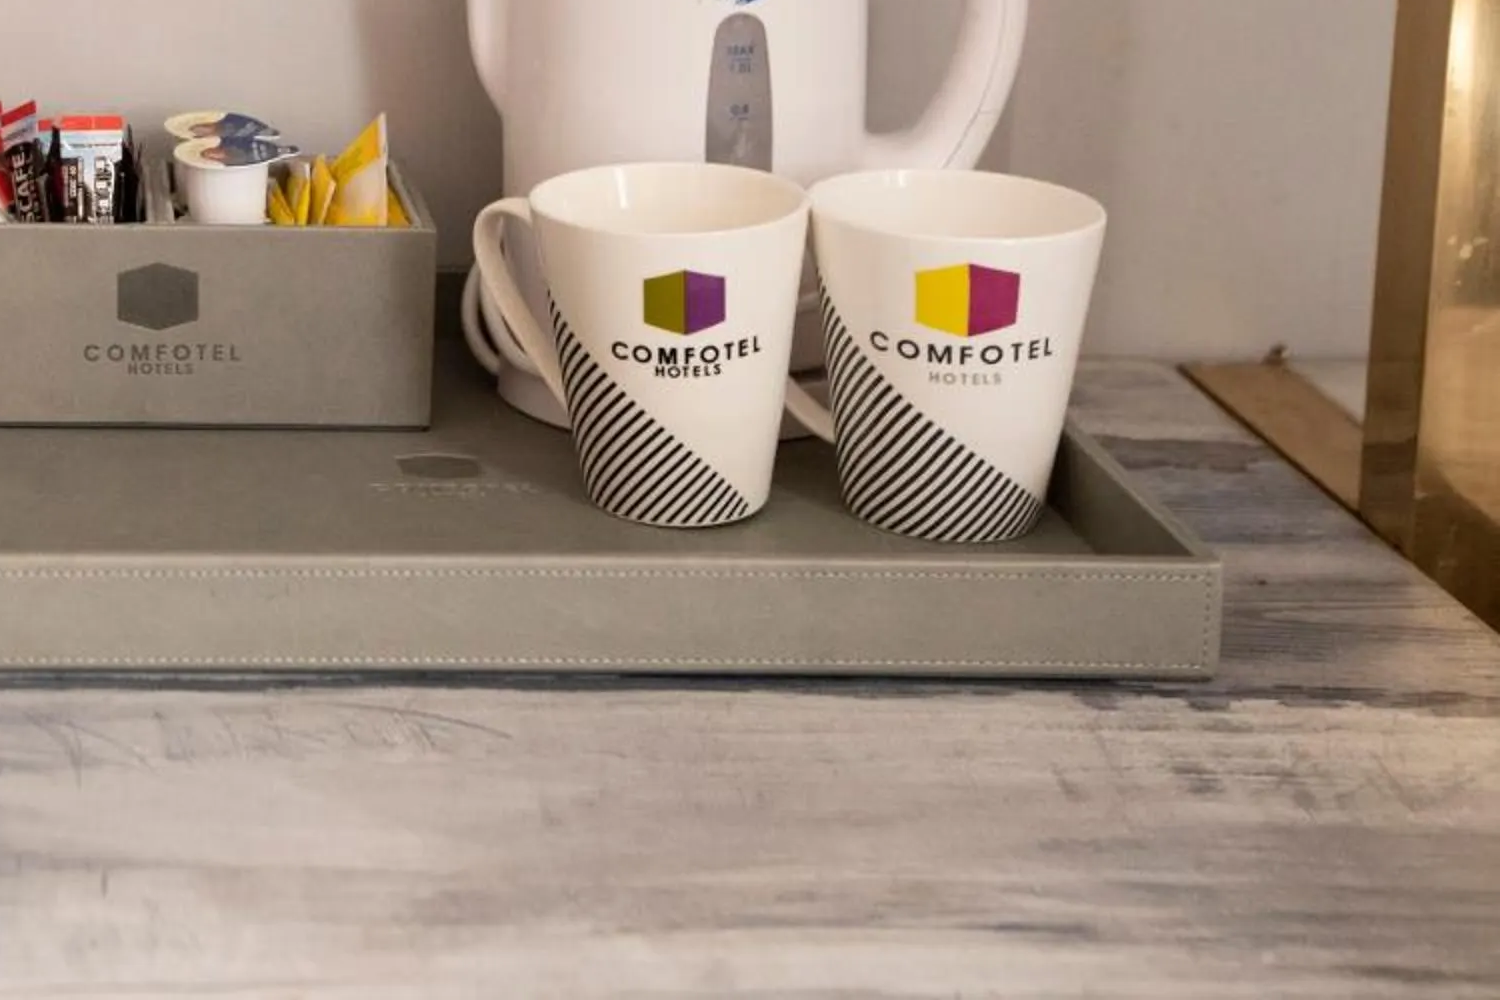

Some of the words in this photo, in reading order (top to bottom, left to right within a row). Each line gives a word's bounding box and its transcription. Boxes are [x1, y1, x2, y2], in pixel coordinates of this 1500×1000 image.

[83, 343, 242, 362] COMFOTEL
[611, 336, 761, 365] COMFOTEL
[868, 331, 1053, 365] COMFOTEL
[127, 362, 195, 375] HOTELS
[655, 364, 722, 379] HOTELS
[928, 371, 1003, 386] HOTELS
